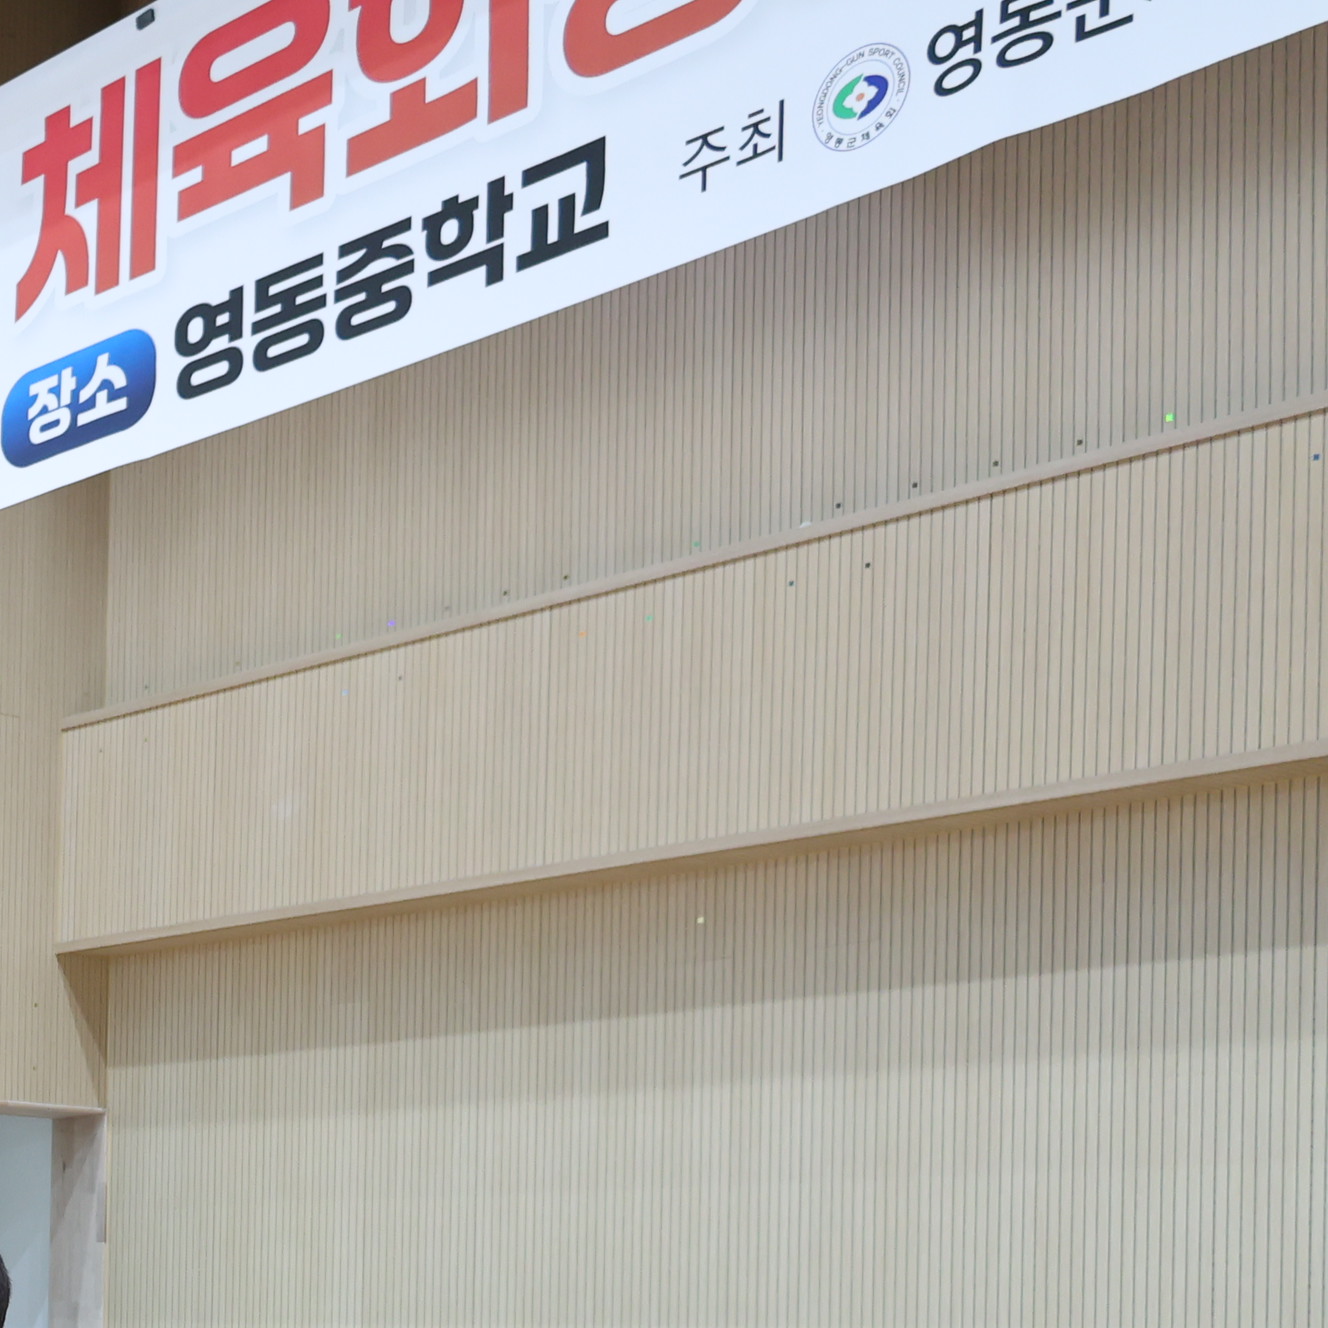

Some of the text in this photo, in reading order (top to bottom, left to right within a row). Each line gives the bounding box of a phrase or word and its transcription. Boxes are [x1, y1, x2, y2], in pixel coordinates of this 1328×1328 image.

[678, 98, 786, 193] 주최
[27, 136, 610, 446] 장소 영동중학교
